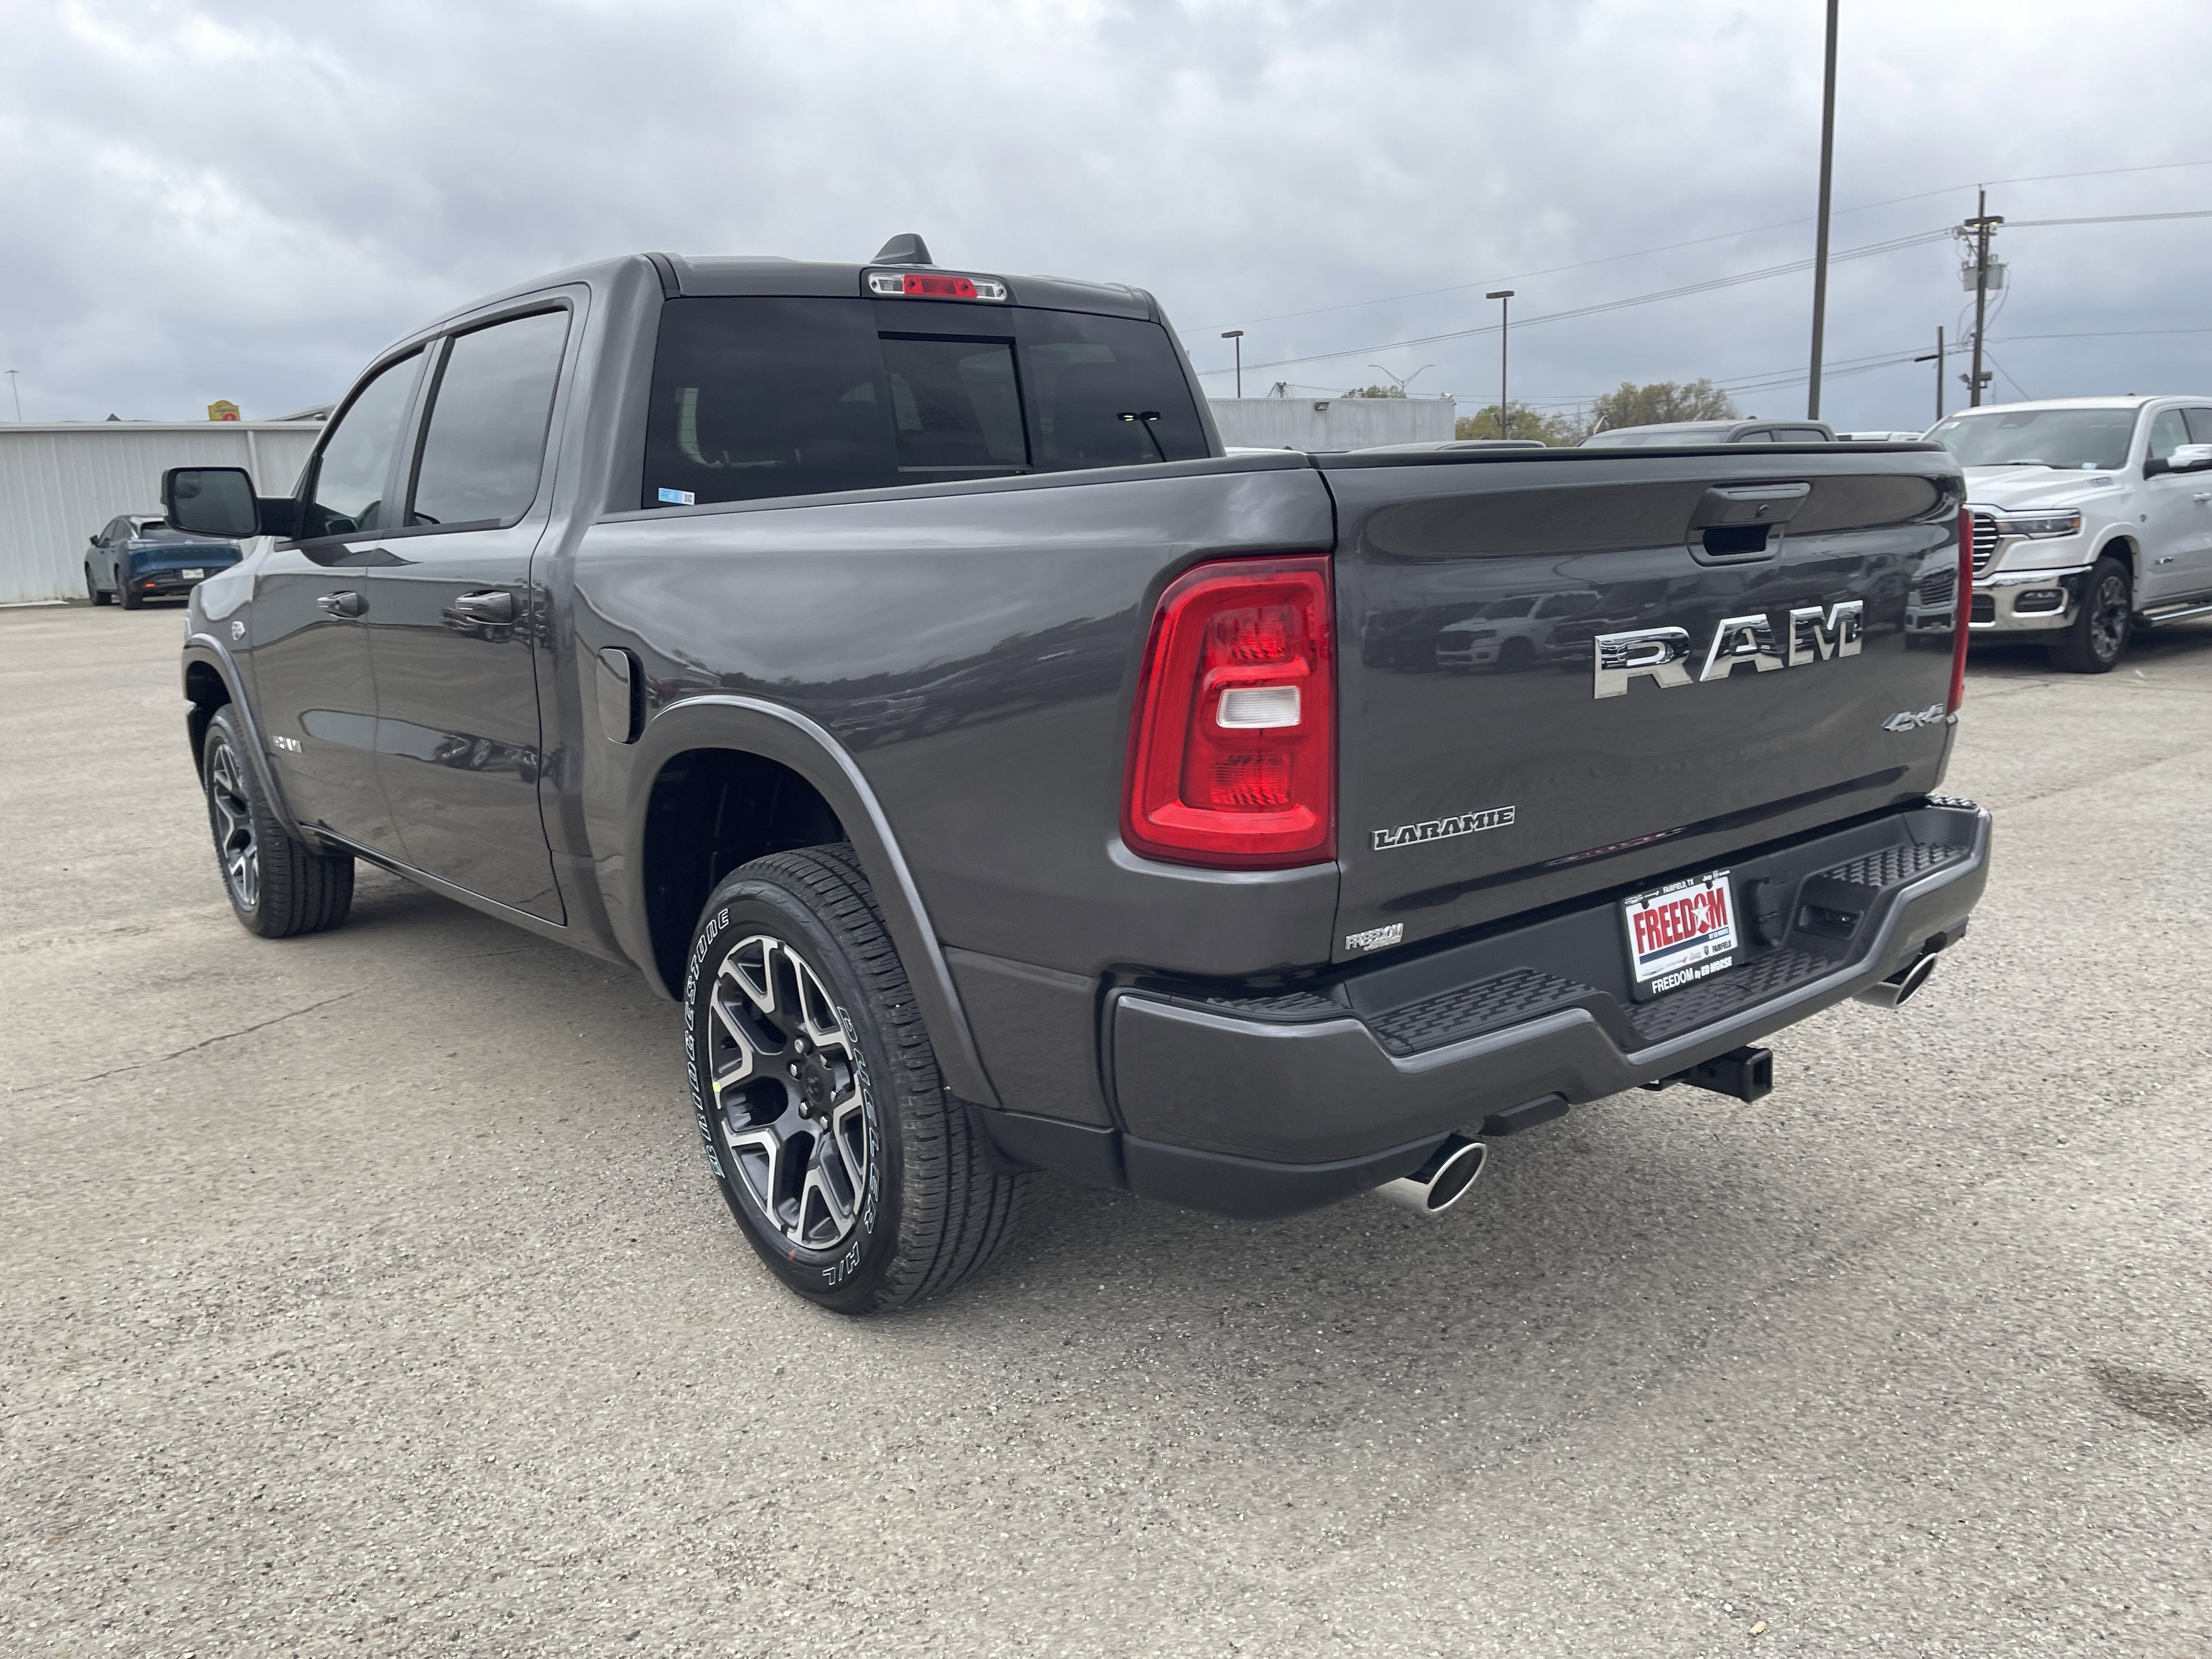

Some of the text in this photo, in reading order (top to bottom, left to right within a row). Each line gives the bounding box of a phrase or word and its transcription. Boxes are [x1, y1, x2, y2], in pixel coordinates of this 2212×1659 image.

[1594, 600, 1863, 699] RAM
[1372, 805, 1515, 851] LARAMIE
[1633, 887, 1728, 954] FREEDOM
[1651, 967, 1694, 994] FREEDOM
[1701, 964, 1710, 977] ED
[1710, 956, 1733, 973] MORSE
[685, 908, 729, 1178] BRIDGESTONE
[822, 1006, 879, 1285] DUELER H/L
